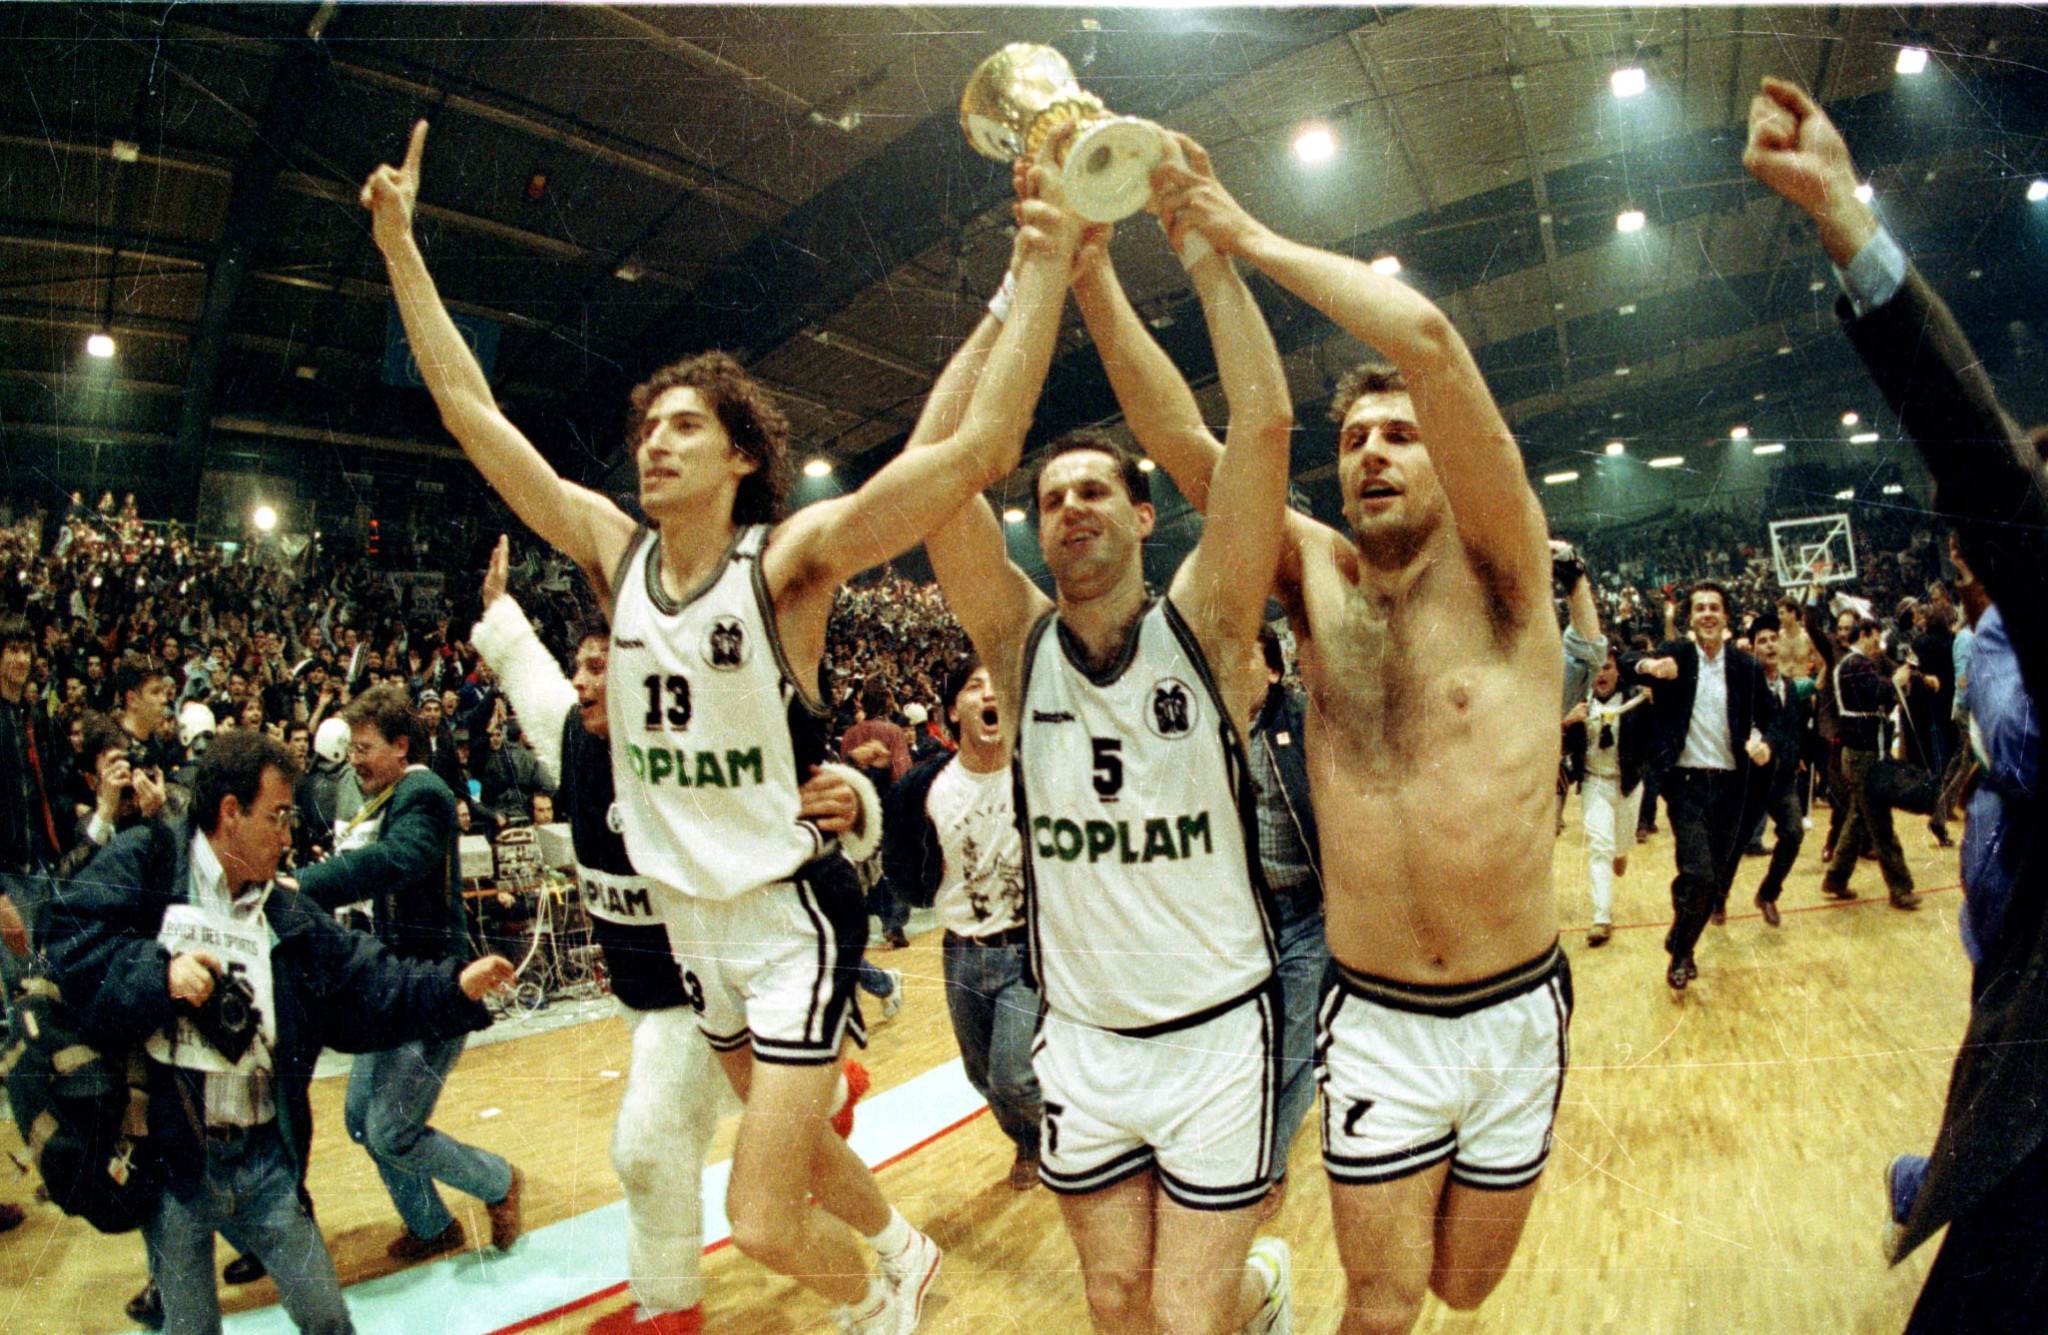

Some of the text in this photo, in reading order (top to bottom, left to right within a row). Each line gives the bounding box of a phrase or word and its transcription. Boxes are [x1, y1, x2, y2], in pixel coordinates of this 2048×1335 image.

[644, 674, 692, 727] 13
[1092, 736, 1123, 797] 5
[1033, 811, 1213, 864] COPLAM
[1344, 1096, 1374, 1137] 7
